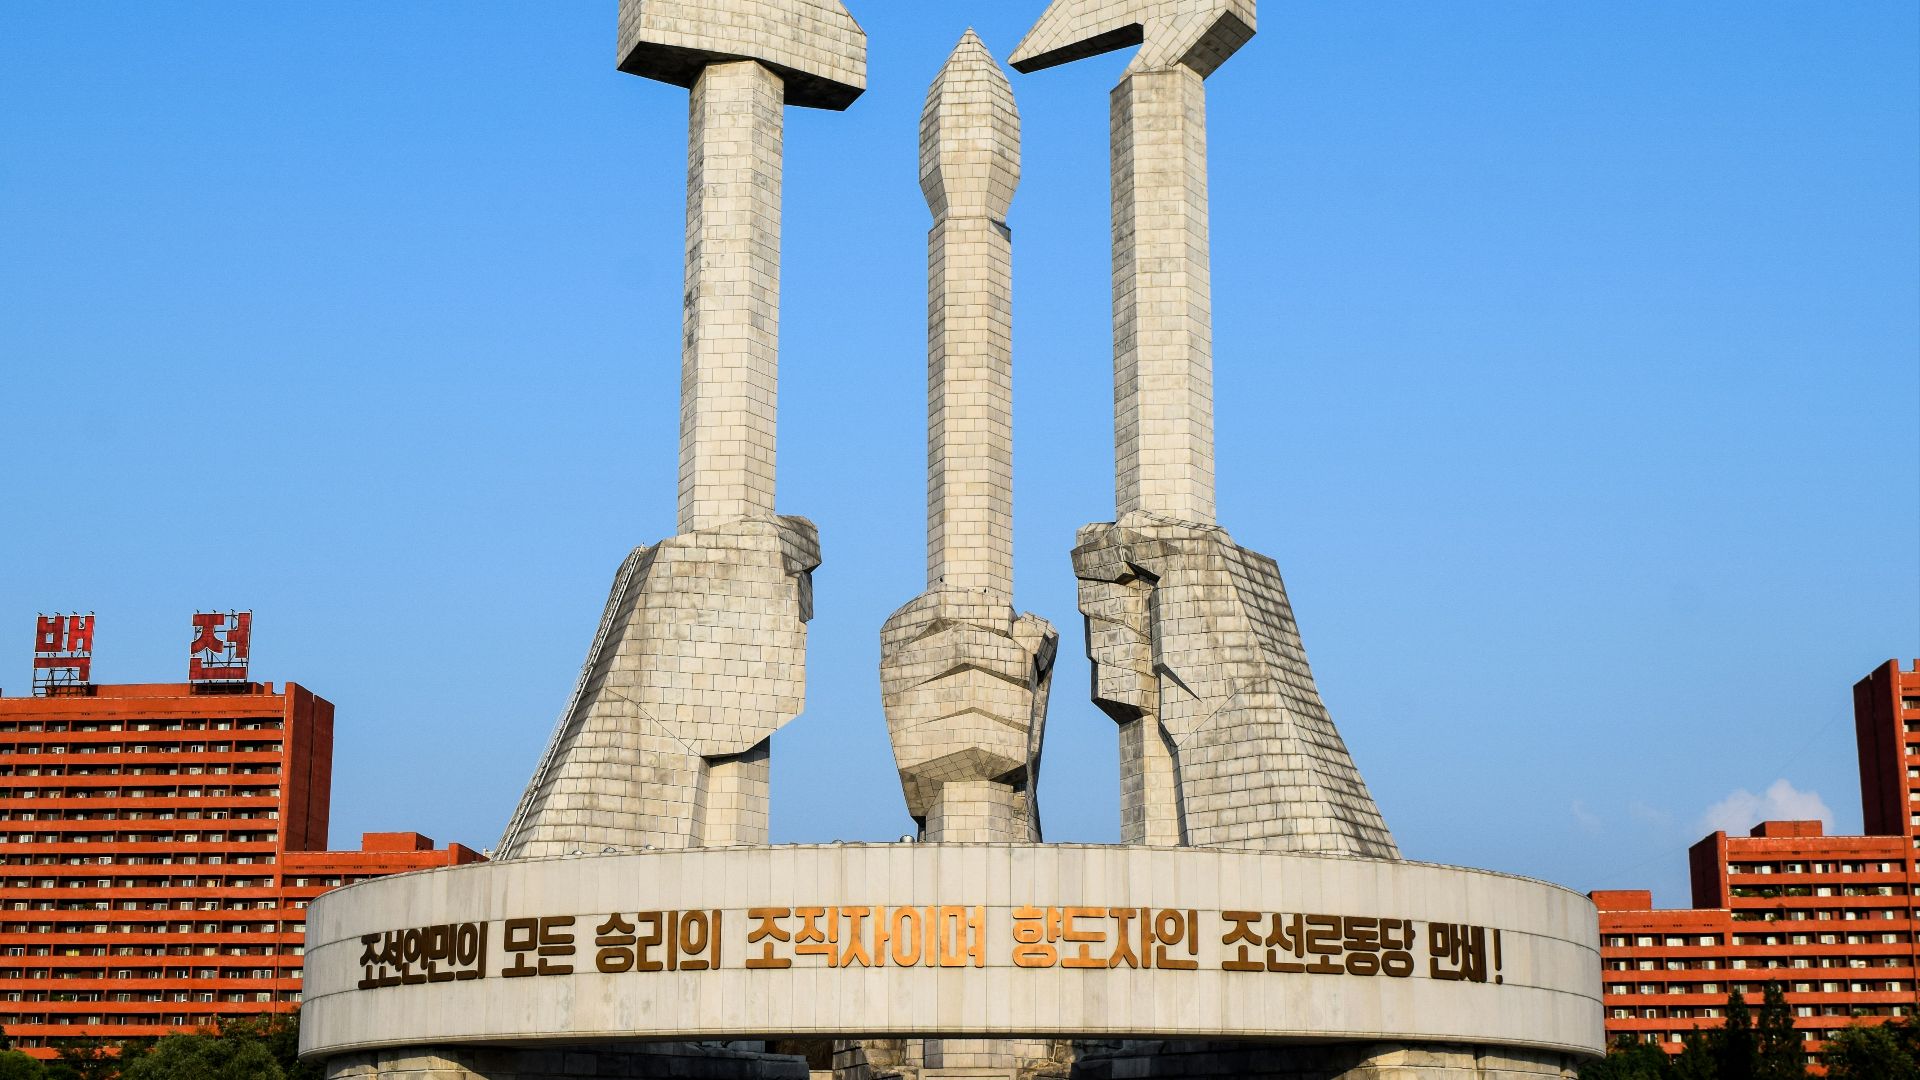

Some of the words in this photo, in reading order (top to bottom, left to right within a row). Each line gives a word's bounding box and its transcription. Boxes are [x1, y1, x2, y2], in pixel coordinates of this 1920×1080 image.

[33, 614, 95, 682] 백
[188, 612, 252, 681] 전
[358, 921, 488, 990] 조선인민의
[501, 915, 576, 978] 모든
[594, 908, 722, 974] 승리의
[745, 904, 984, 969] 조직자이며
[1011, 903, 1198, 970] 향도자인
[1221, 909, 1416, 977] 조선로동당
[1428, 921, 1503, 985] 만세!
